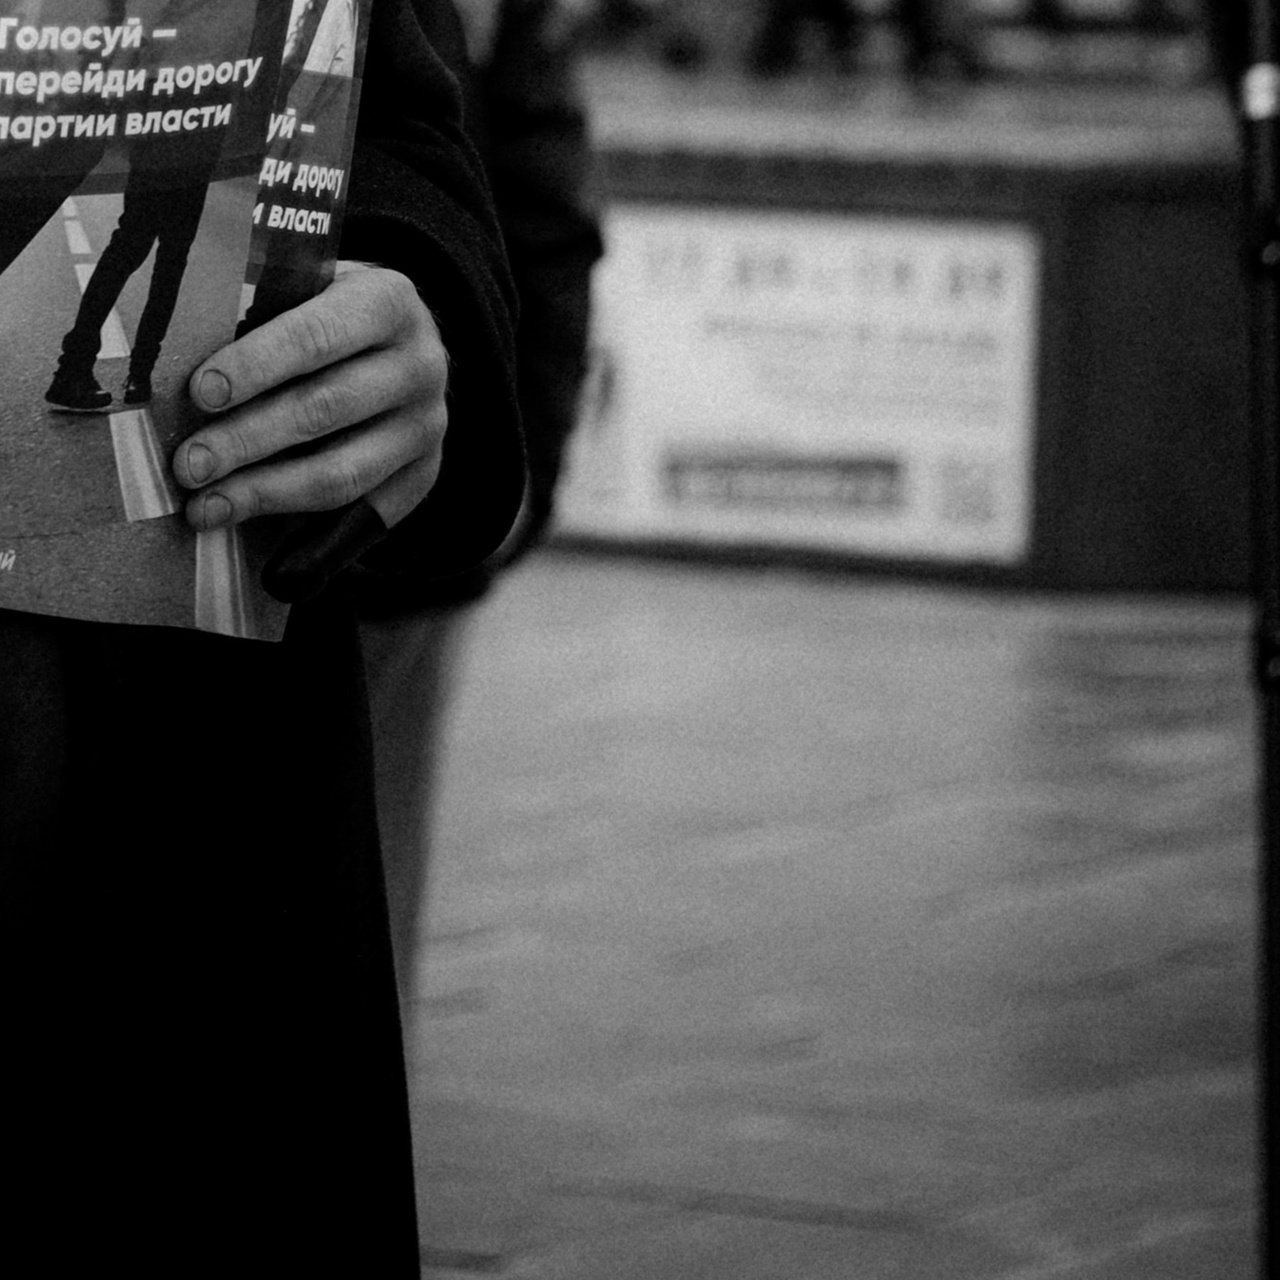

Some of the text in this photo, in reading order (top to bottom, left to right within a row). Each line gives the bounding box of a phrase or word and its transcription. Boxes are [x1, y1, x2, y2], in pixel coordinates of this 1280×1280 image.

[152, 56, 263, 96] дорогу
[124, 102, 232, 136] власти
[292, 163, 345, 200] дорогу
[267, 204, 331, 236] власти
